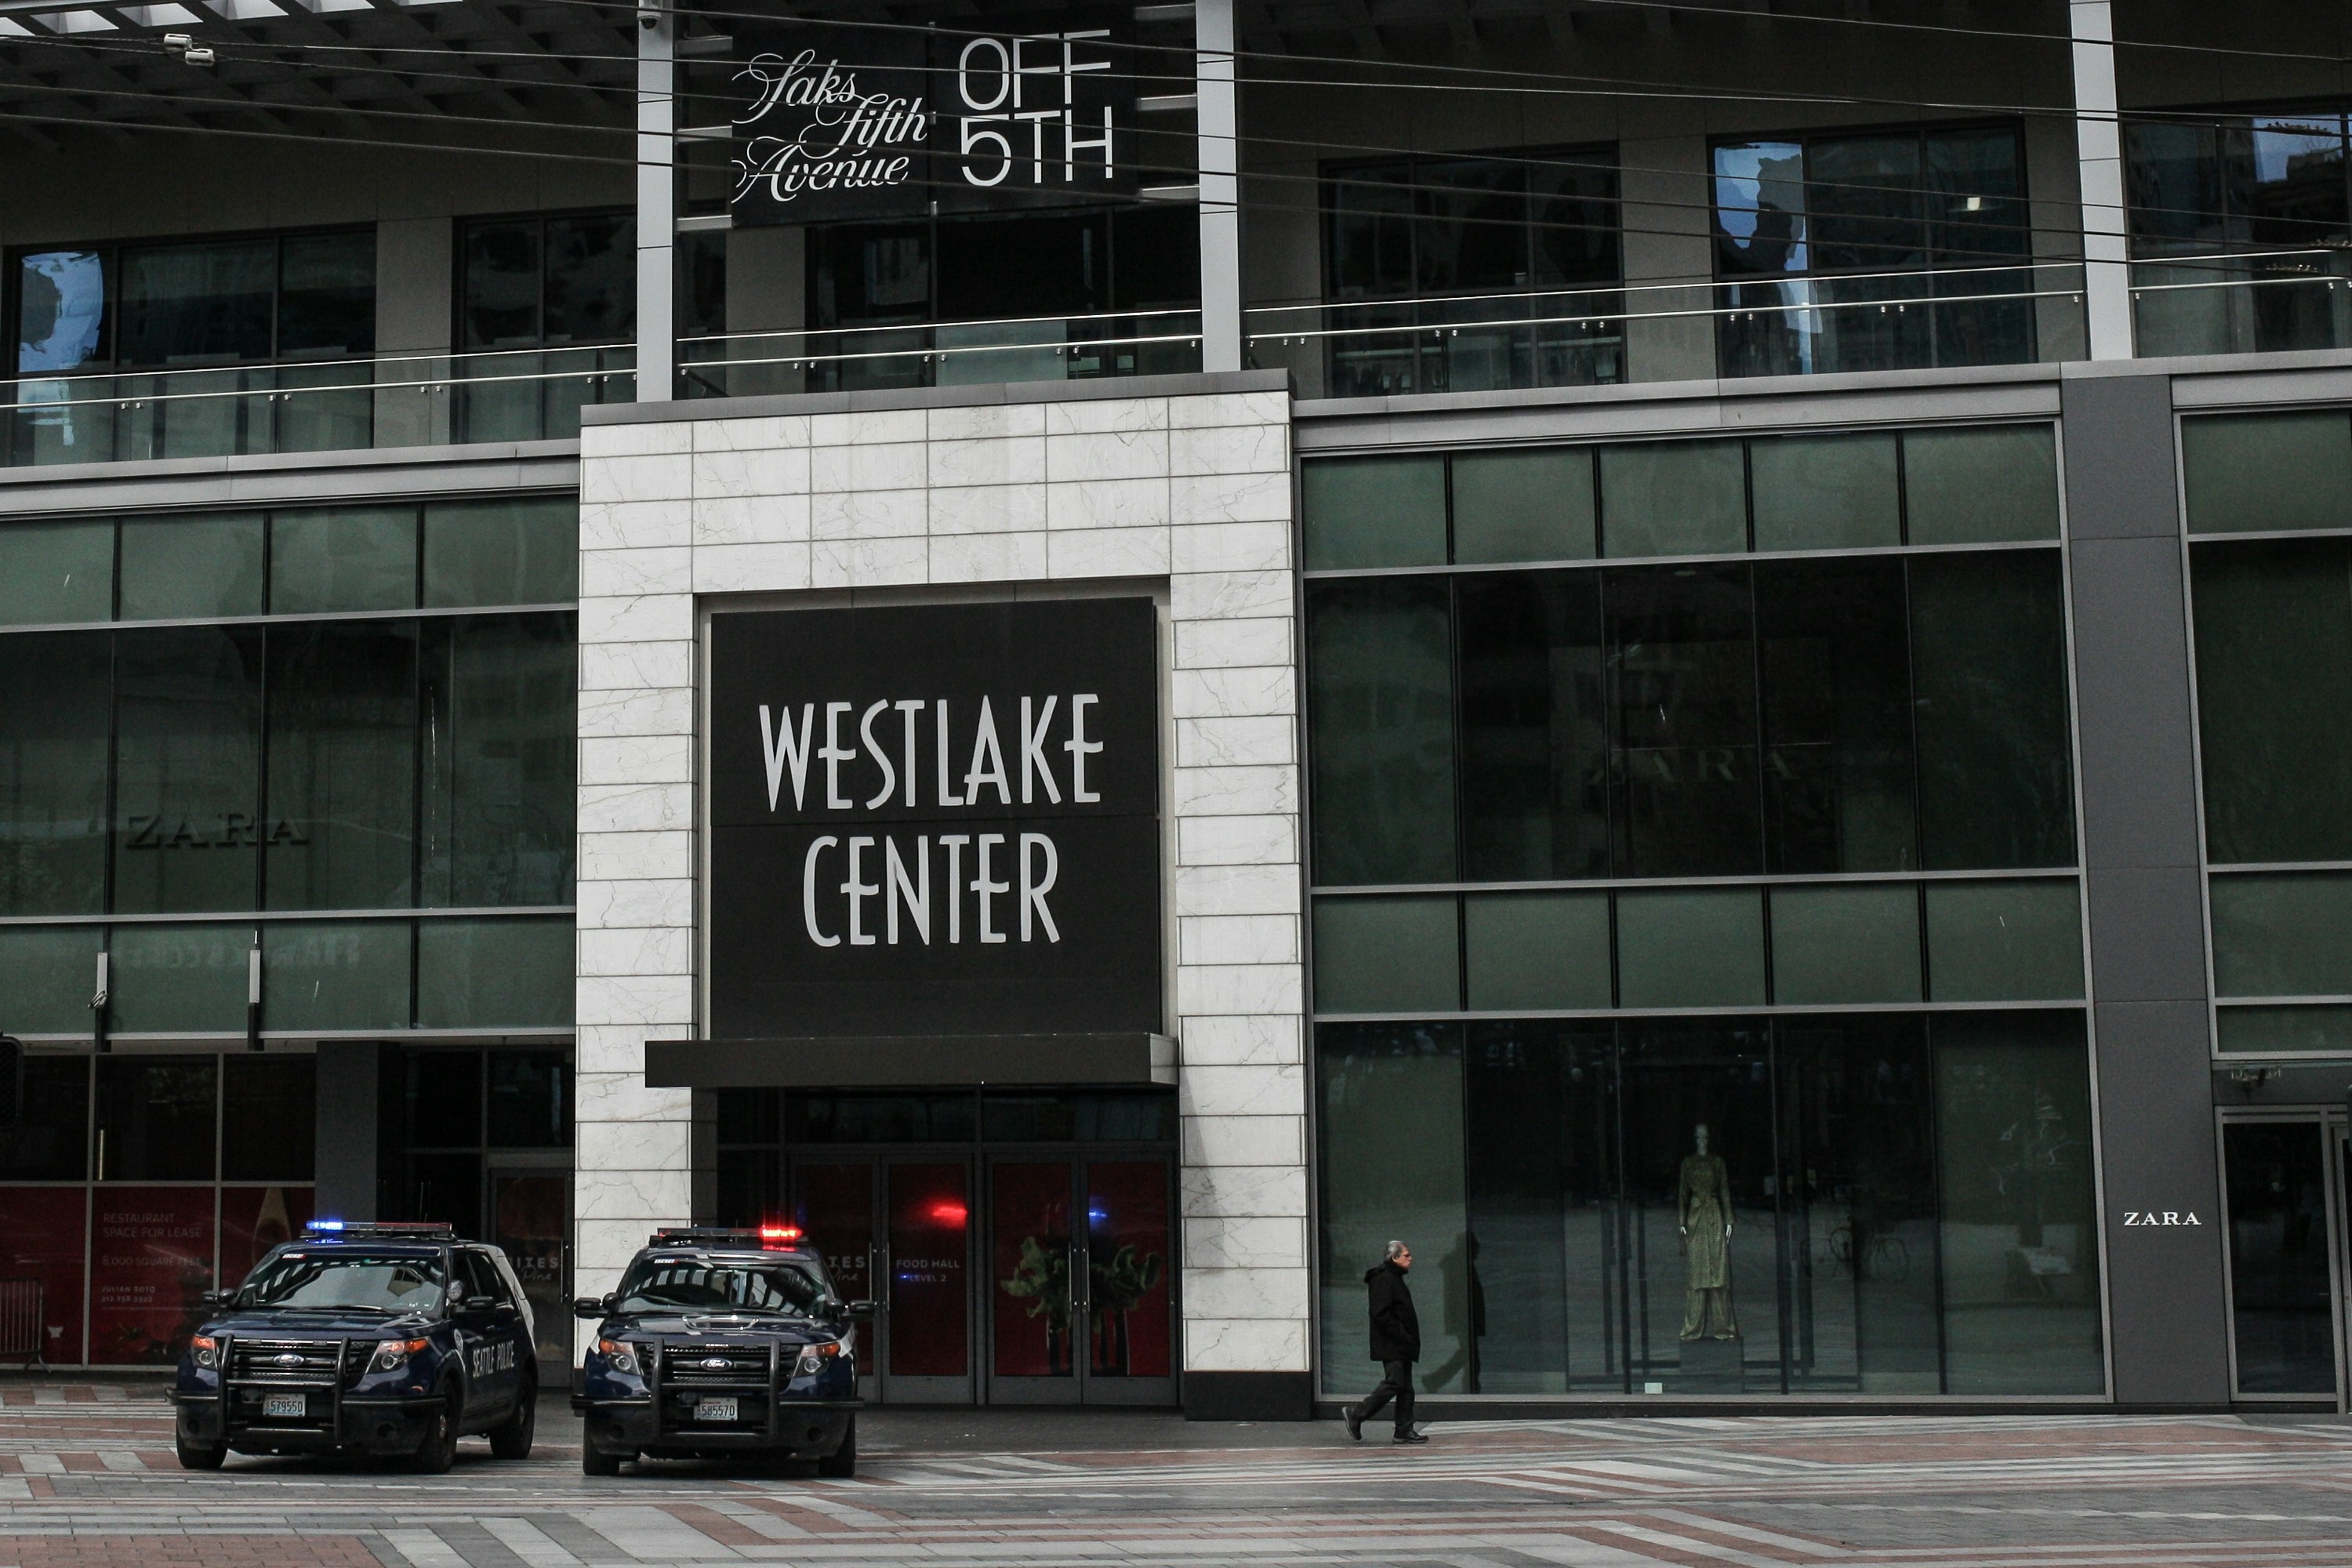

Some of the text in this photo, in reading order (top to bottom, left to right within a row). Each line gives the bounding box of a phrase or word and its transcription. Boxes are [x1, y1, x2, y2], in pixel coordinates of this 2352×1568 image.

[731, 49, 857, 125] Saks
[959, 29, 1111, 111] OFF
[800, 93, 927, 157] Fifth
[960, 106, 1114, 187] 5TH
[731, 136, 909, 204] Avenue
[758, 693, 1104, 812] WESTLAKE
[126, 811, 310, 849] ZARA
[802, 833, 1061, 947] CENTER
[103, 1213, 175, 1223] RESTAURANT
[103, 1227, 201, 1237] SPACE FOR LEASE
[2124, 1211, 2202, 1226] ZARA
[102, 1256, 132, 1267] 8,000
[136, 1256, 175, 1267] SQUARE
[896, 1259, 960, 1269] FOOD HALL
[473, 1340, 514, 1377] SEATTLE POLICE
